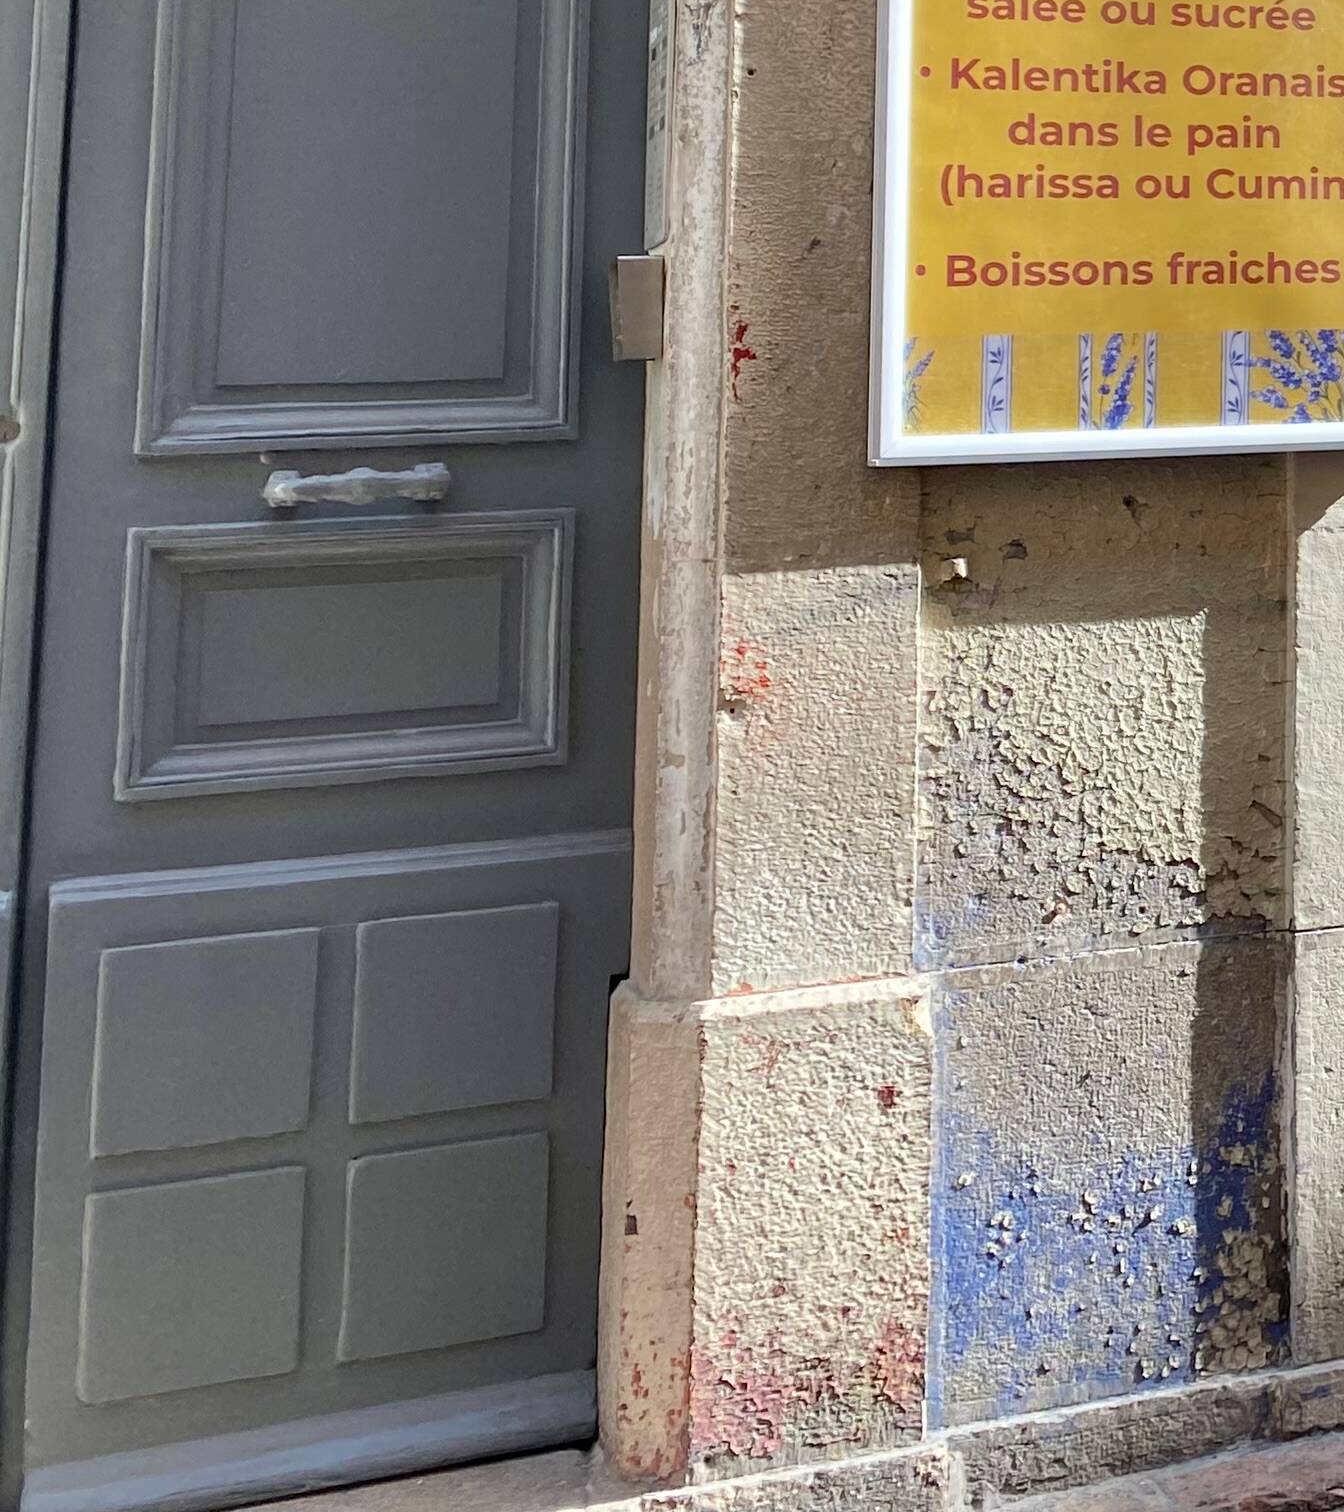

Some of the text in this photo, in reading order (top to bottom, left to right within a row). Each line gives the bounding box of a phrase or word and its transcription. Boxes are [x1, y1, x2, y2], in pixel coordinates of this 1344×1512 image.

[1101, 1, 1155, 25] ou
[1171, 0, 1315, 30] sucrée
[952, 58, 1166, 94] Kalentika
[1009, 113, 1280, 155] dans le pain
[941, 164, 1119, 206] (harissa
[1136, 175, 1190, 199] ou
[947, 250, 1340, 287] Boissons fraiches
